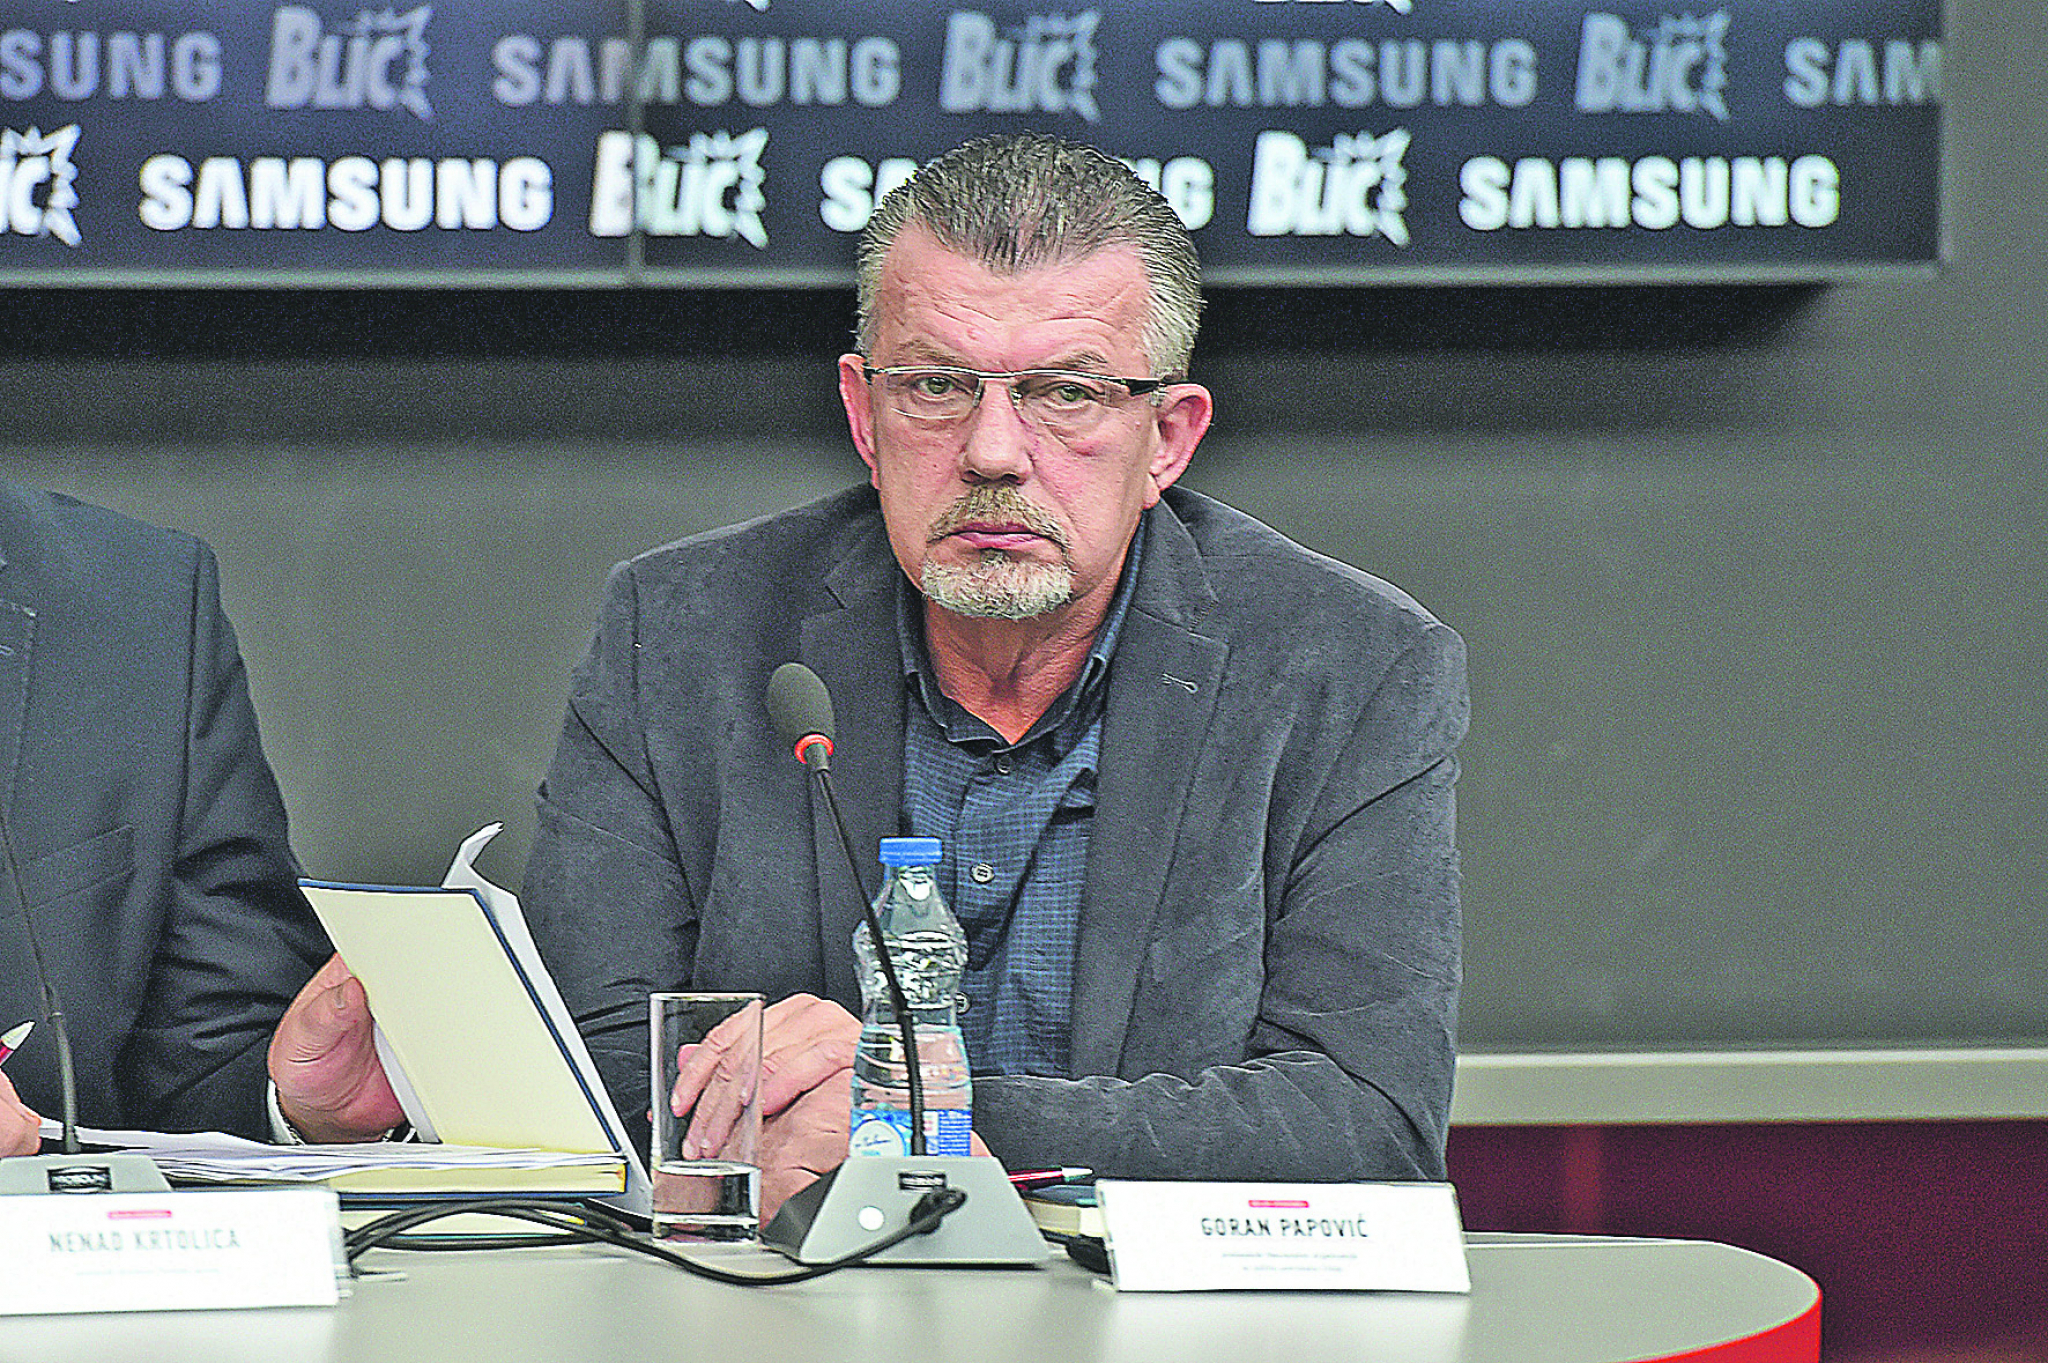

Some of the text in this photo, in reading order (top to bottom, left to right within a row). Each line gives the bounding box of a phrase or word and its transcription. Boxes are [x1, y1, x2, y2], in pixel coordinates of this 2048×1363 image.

[491, 35, 898, 106] SAMSUNG
[1155, 38, 1537, 108] SAMSUNG
[139, 155, 553, 231] SAMSUNG
[1459, 156, 1840, 230] SAMSUNG
[50, 1228, 240, 1252] NENAD KRTOLICA
[1201, 1212, 1369, 1237] GORAN PAPOVIĆ
